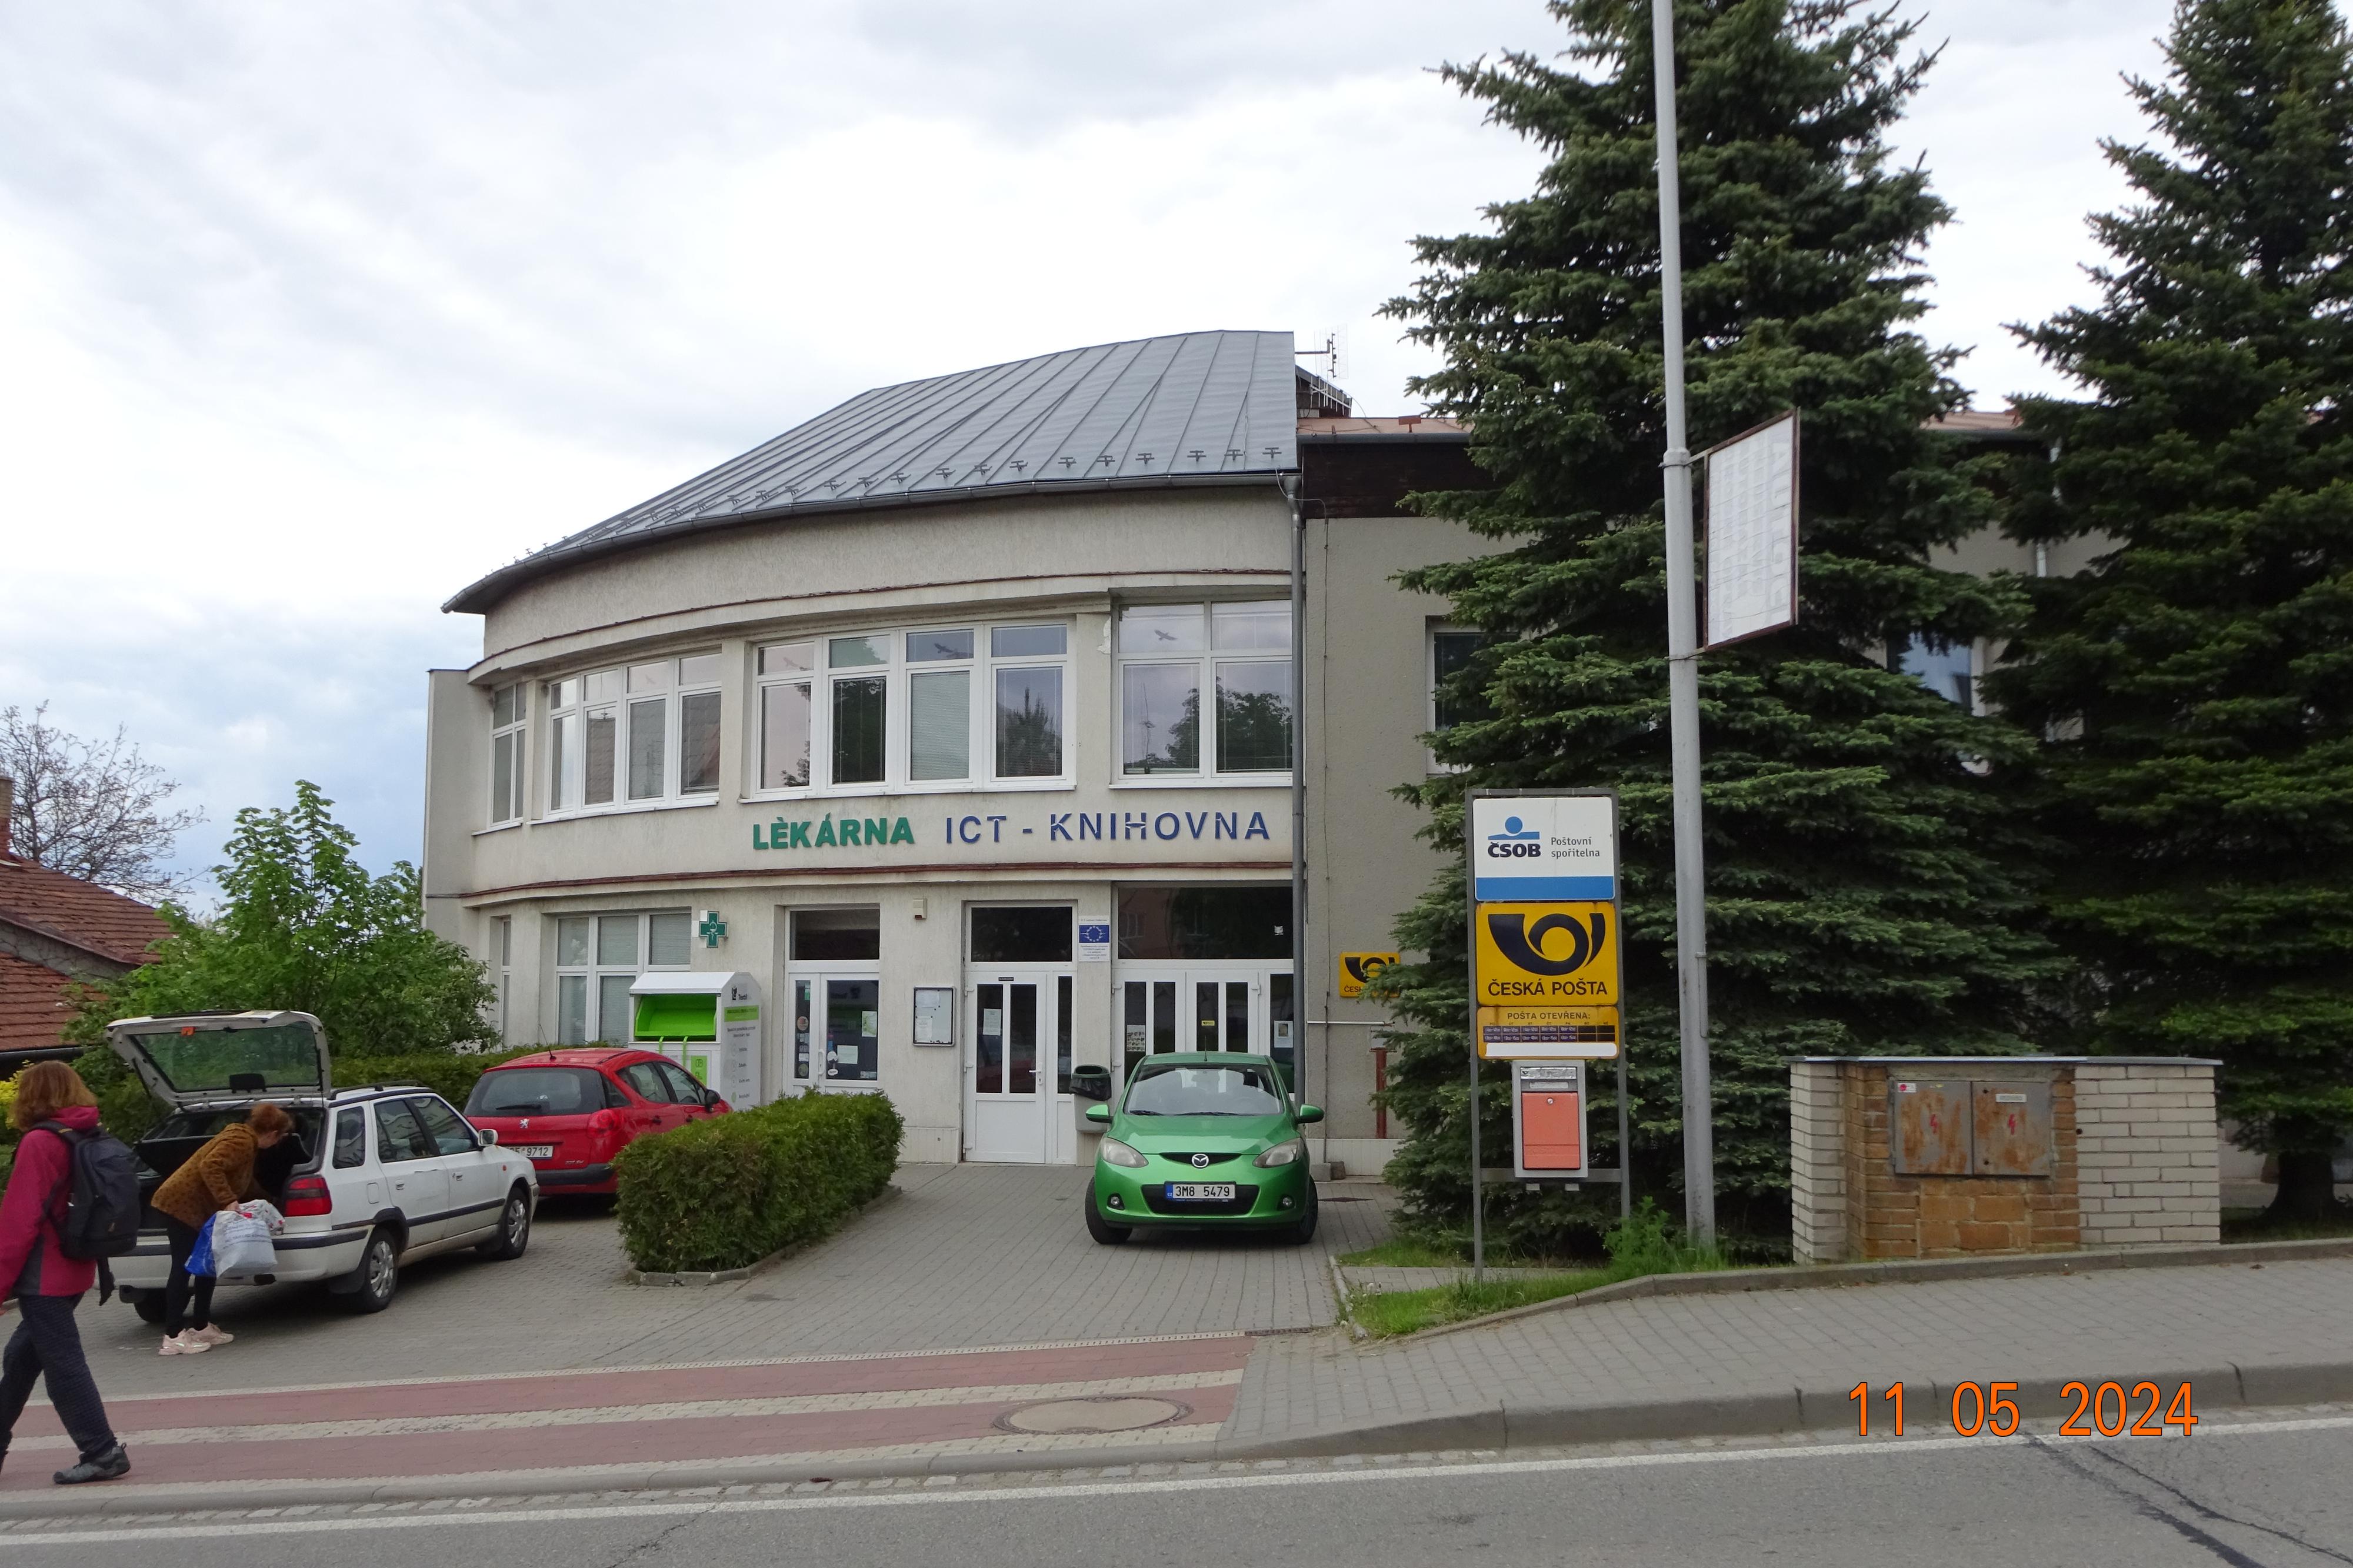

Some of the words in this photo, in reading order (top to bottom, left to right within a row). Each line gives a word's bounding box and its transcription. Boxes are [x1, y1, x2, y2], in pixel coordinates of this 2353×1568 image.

[946, 815, 1007, 844] ICT
[1050, 811, 1270, 842] KNIHOVNA
[1551, 836, 1592, 846] Poštovní
[1487, 842, 1541, 858] ČSOB
[1551, 848, 1600, 859] spořitelna
[1488, 978, 1545, 996] ČESKÁ
[1552, 978, 1608, 995] POŠTA
[1507, 1011, 1537, 1020] POŠTA
[1539, 1011, 1591, 1019] OTEVŘENA:
[526, 1147, 548, 1156] 9712
[1175, 1186, 1195, 1197] 3M8
[1204, 1186, 1229, 1197] 5479
